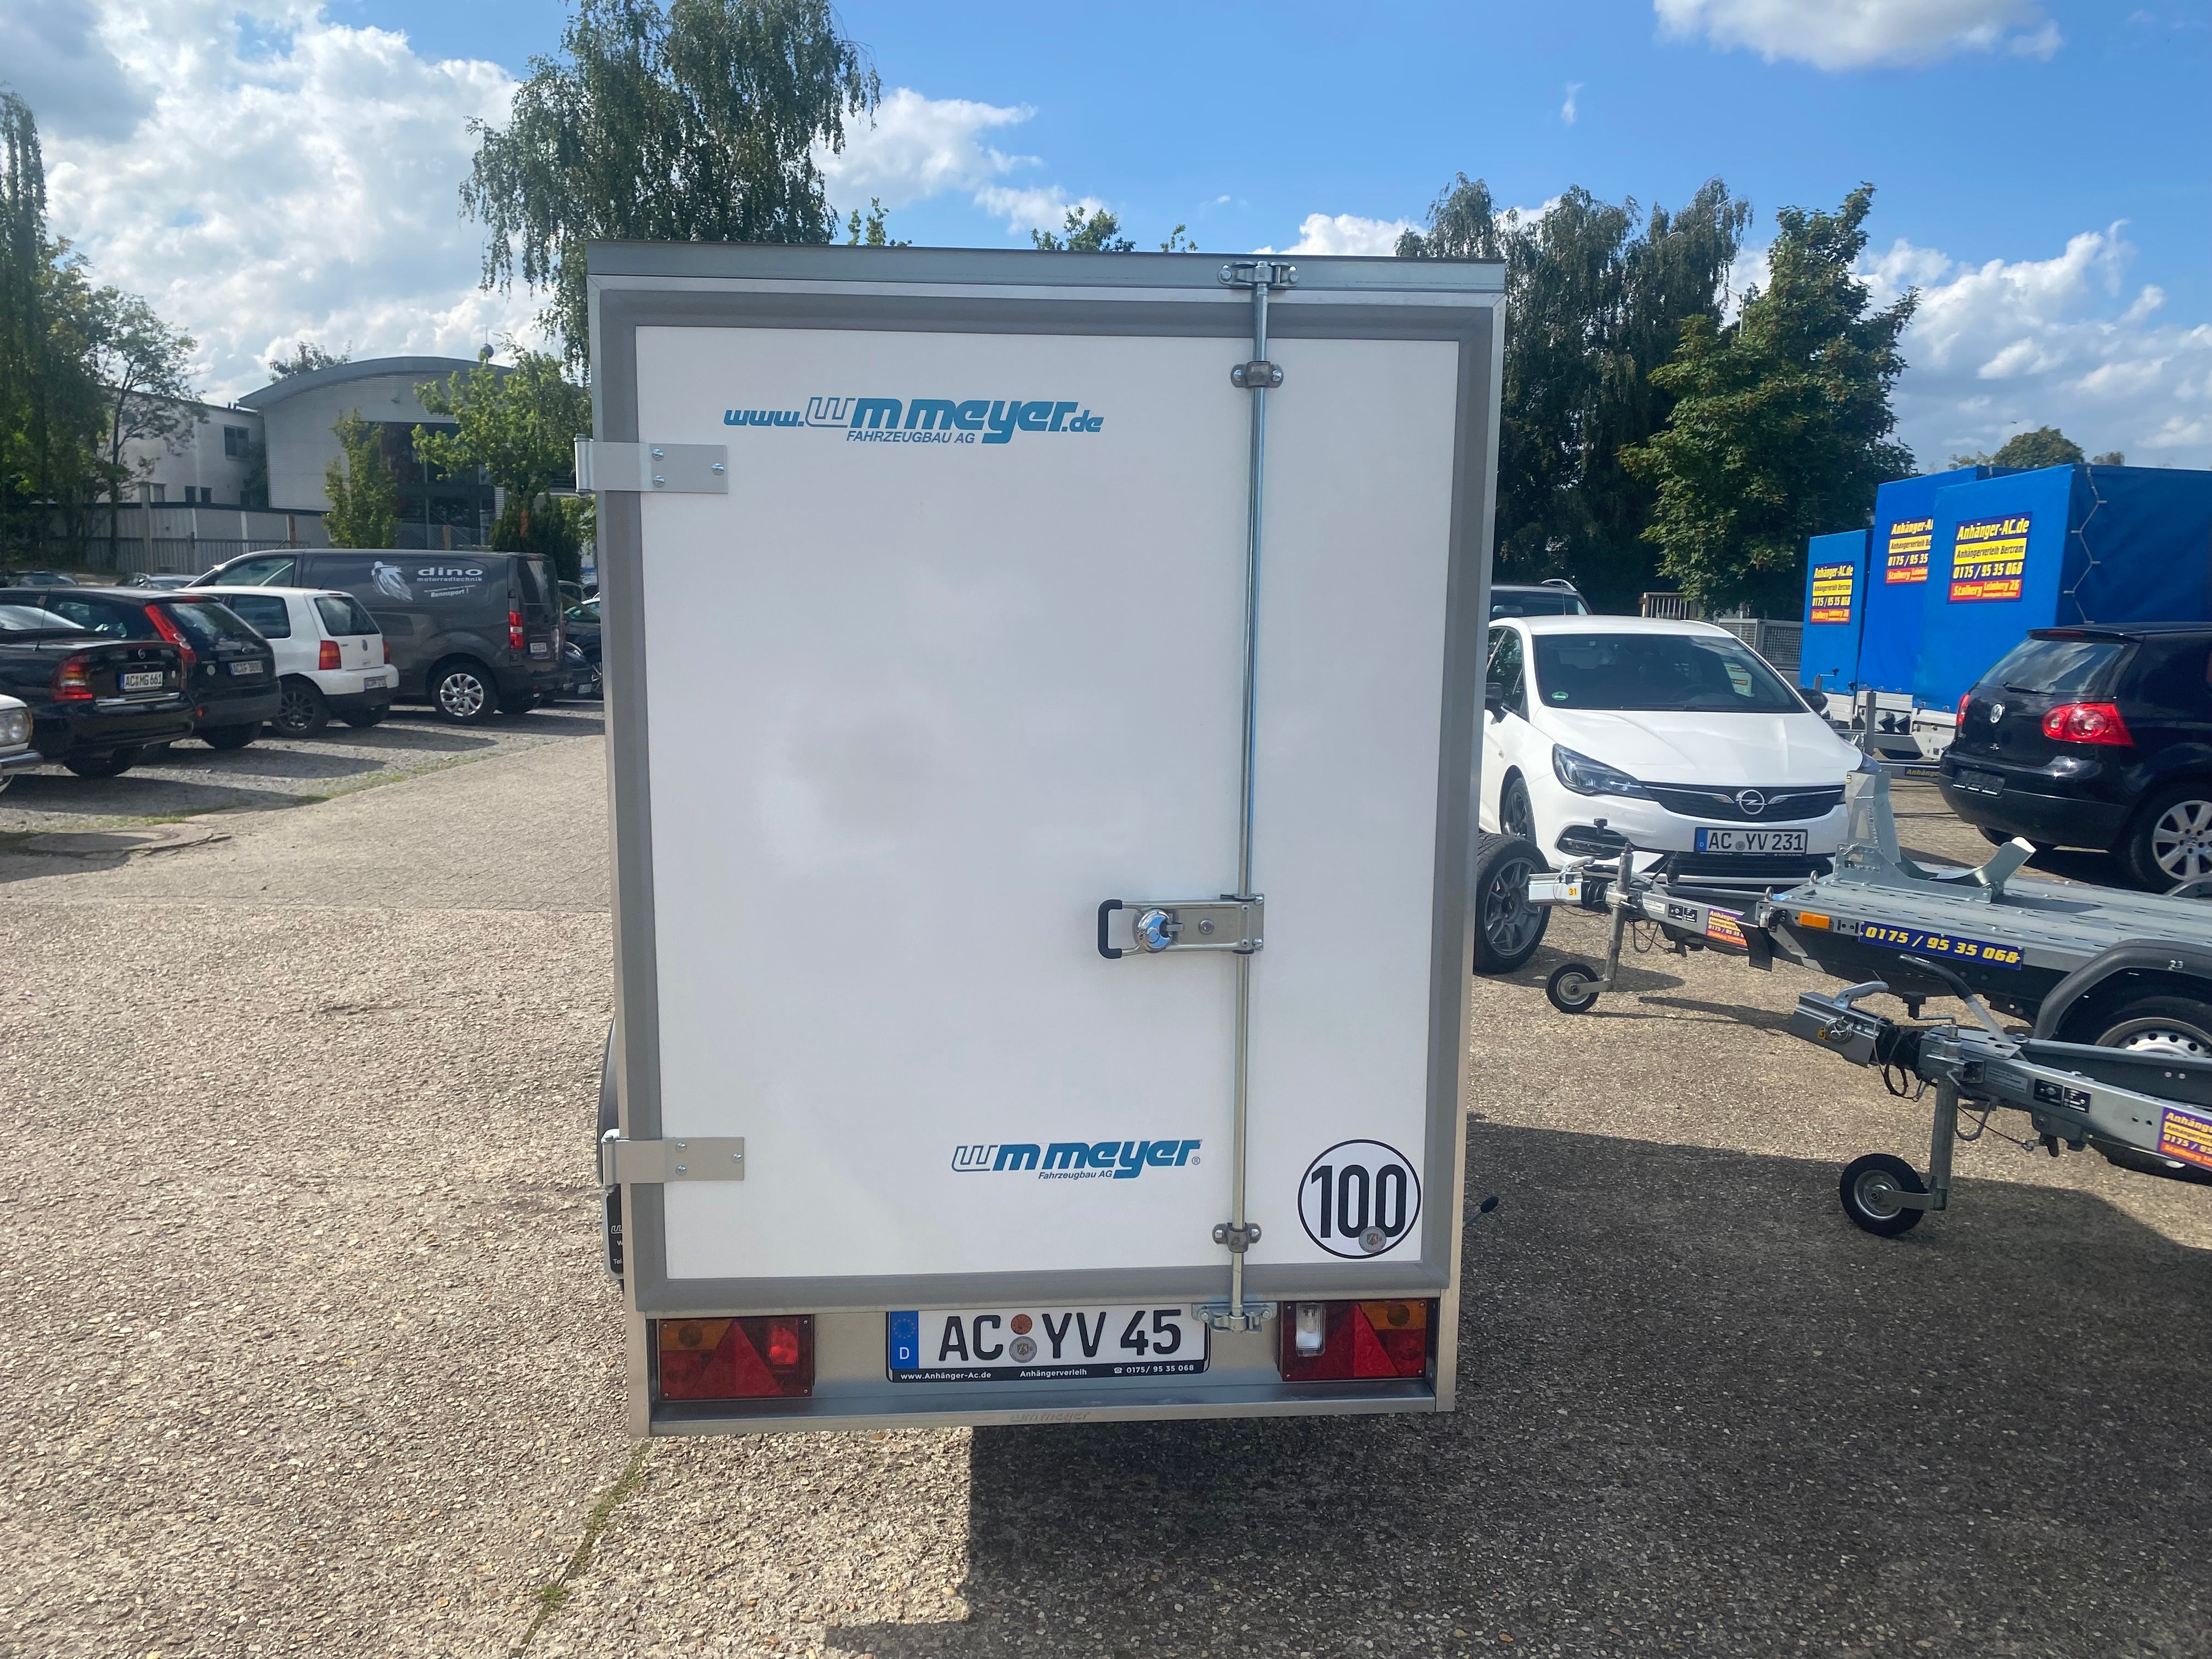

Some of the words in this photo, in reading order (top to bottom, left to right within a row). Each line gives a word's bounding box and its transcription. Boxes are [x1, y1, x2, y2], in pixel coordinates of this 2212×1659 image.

[846, 430, 952, 443] FAHRZEUGBAU
[954, 431, 975, 444] AG
[1956, 518, 2029, 540] Anhänger-AC.de
[1957, 547, 1999, 558] Anhängerverleih
[2000, 545, 2024, 554] Bertram
[1888, 555, 1904, 566] 0175
[1909, 554, 1919, 565] 95
[1919, 553, 1928, 563] 35
[418, 567, 483, 575] dino
[1814, 565, 1854, 579] Anhänger-AC.de
[1953, 565, 1974, 579] 0175
[1981, 564, 1991, 577] 95
[1993, 563, 2004, 576] 35
[2006, 561, 2023, 575] 068
[2009, 580, 2019, 590] 26
[431, 589, 464, 597] Rennsport
[150, 674, 161, 685] 661
[1708, 833, 1732, 849] AC
[1746, 833, 1768, 850] YV
[1771, 834, 1803, 850] 231
[1865, 927, 1909, 944] 0175
[1927, 938, 1950, 951] 95
[1954, 942, 1978, 956] 35
[1982, 947, 2019, 964] 068
[2163, 1133, 2189, 1147] 0175
[1038, 1171, 1096, 1181] Fahrzeugbau
[1098, 1170, 1113, 1179] AG
[1311, 1164, 1407, 1238] 100
[899, 1347, 910, 1360] D
[938, 1315, 1003, 1361] AC
[1042, 1312, 1106, 1358] YV
[1120, 1310, 1181, 1356] 45
[900, 1372, 991, 1381] www.Anhänger-Ac.de
[1020, 1369, 1087, 1378] Anhängerverleih
[1127, 1365, 1150, 1374] 0175/
